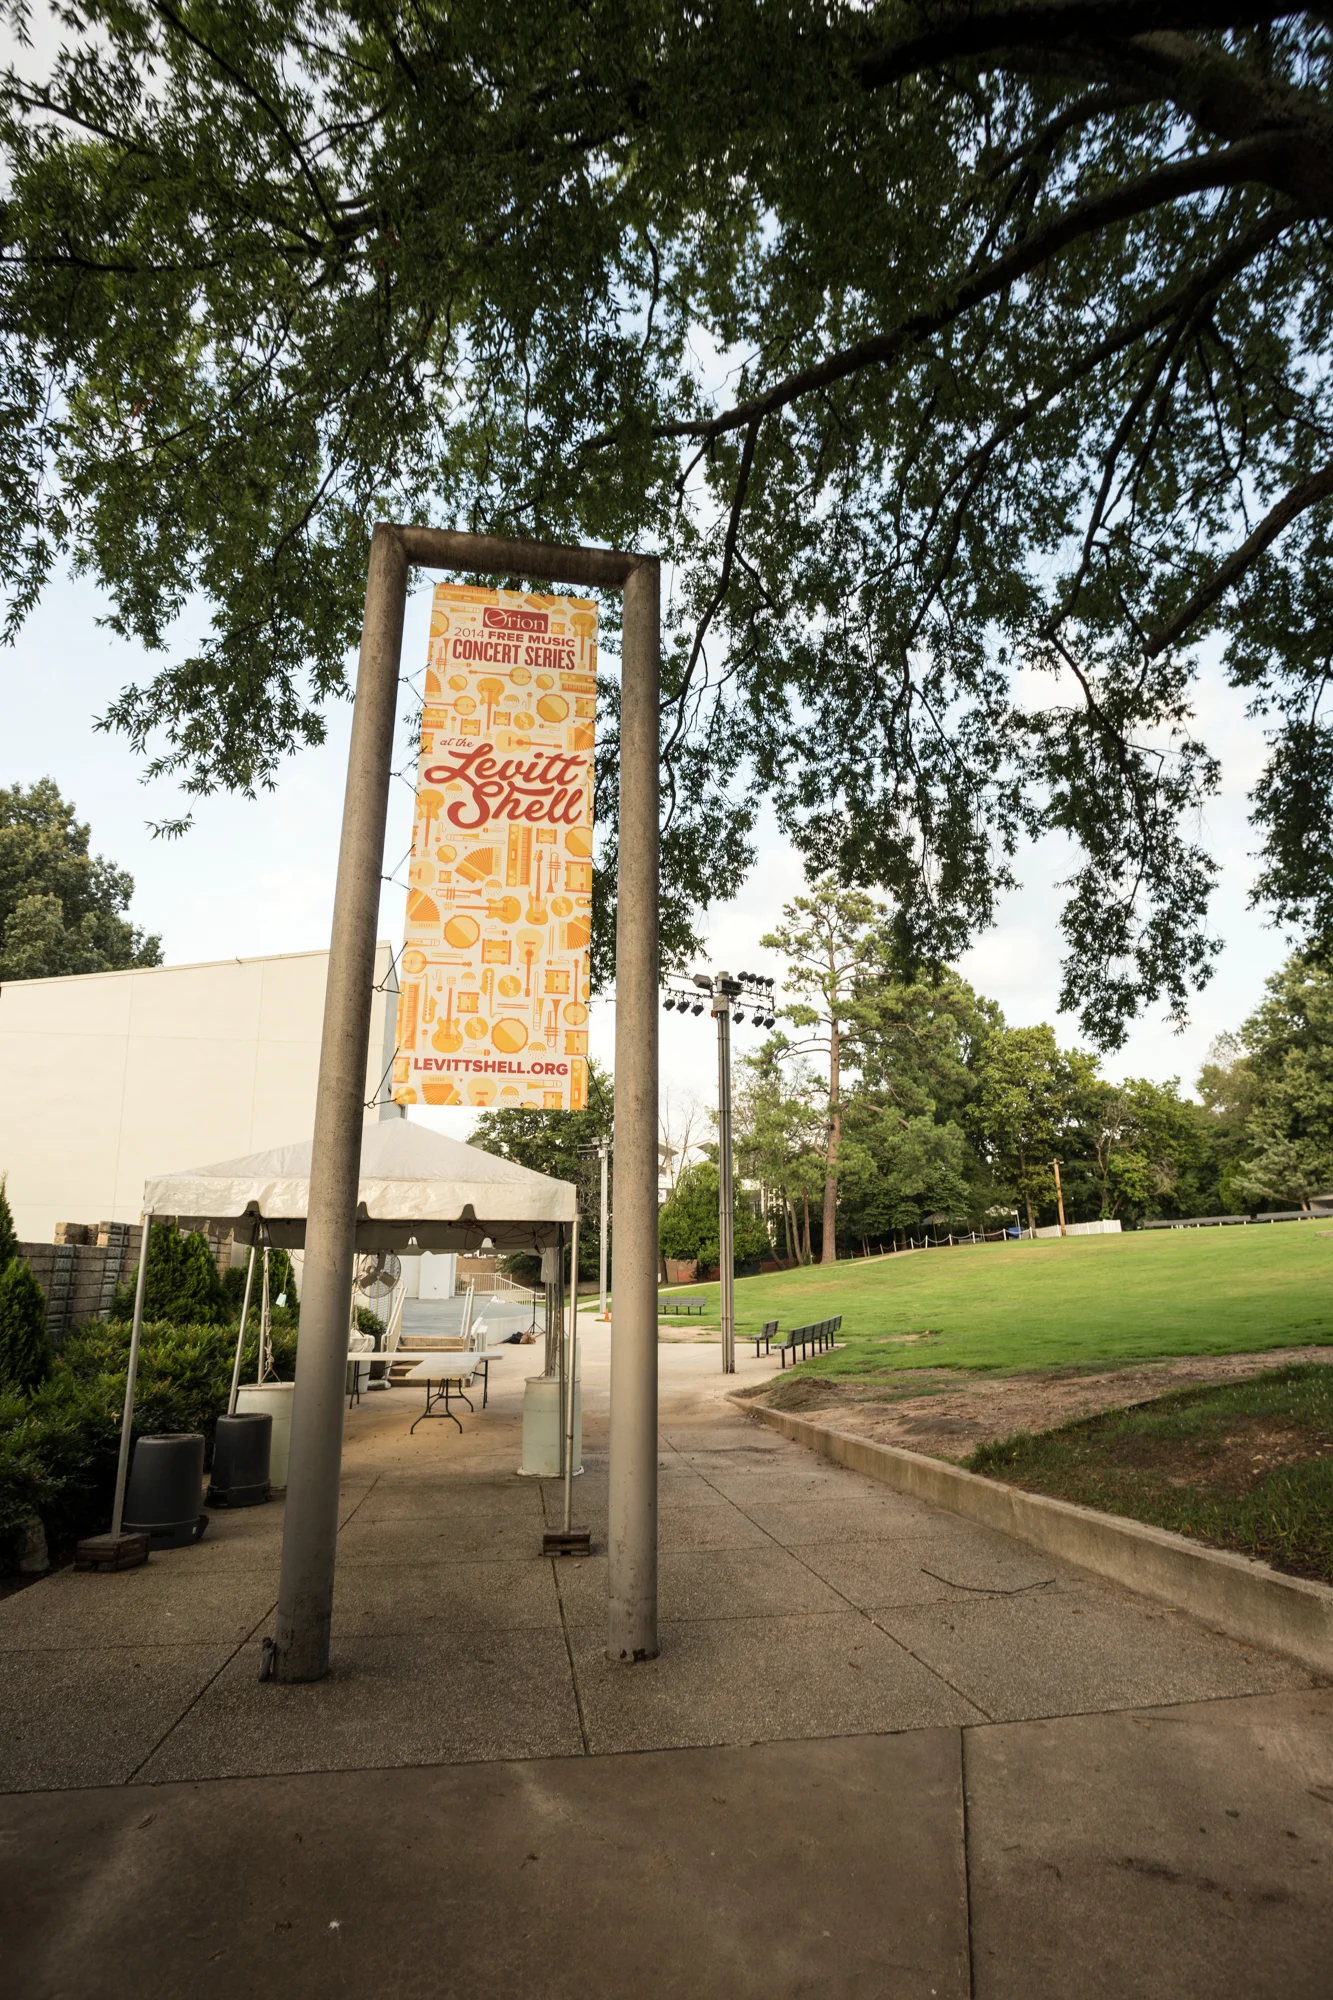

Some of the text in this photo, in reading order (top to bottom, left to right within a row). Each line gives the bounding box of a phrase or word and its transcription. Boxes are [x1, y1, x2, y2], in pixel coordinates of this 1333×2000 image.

[484, 609, 545, 631] Orion
[454, 627, 576, 648] 2014 FREE MUSIC
[452, 638, 576, 671] CONCERT SERIES
[440, 738, 475, 748] at the
[424, 743, 588, 787] Levitt
[447, 781, 584, 830] Shell
[413, 1058, 569, 1076] LEVITTSHELL.ORG
